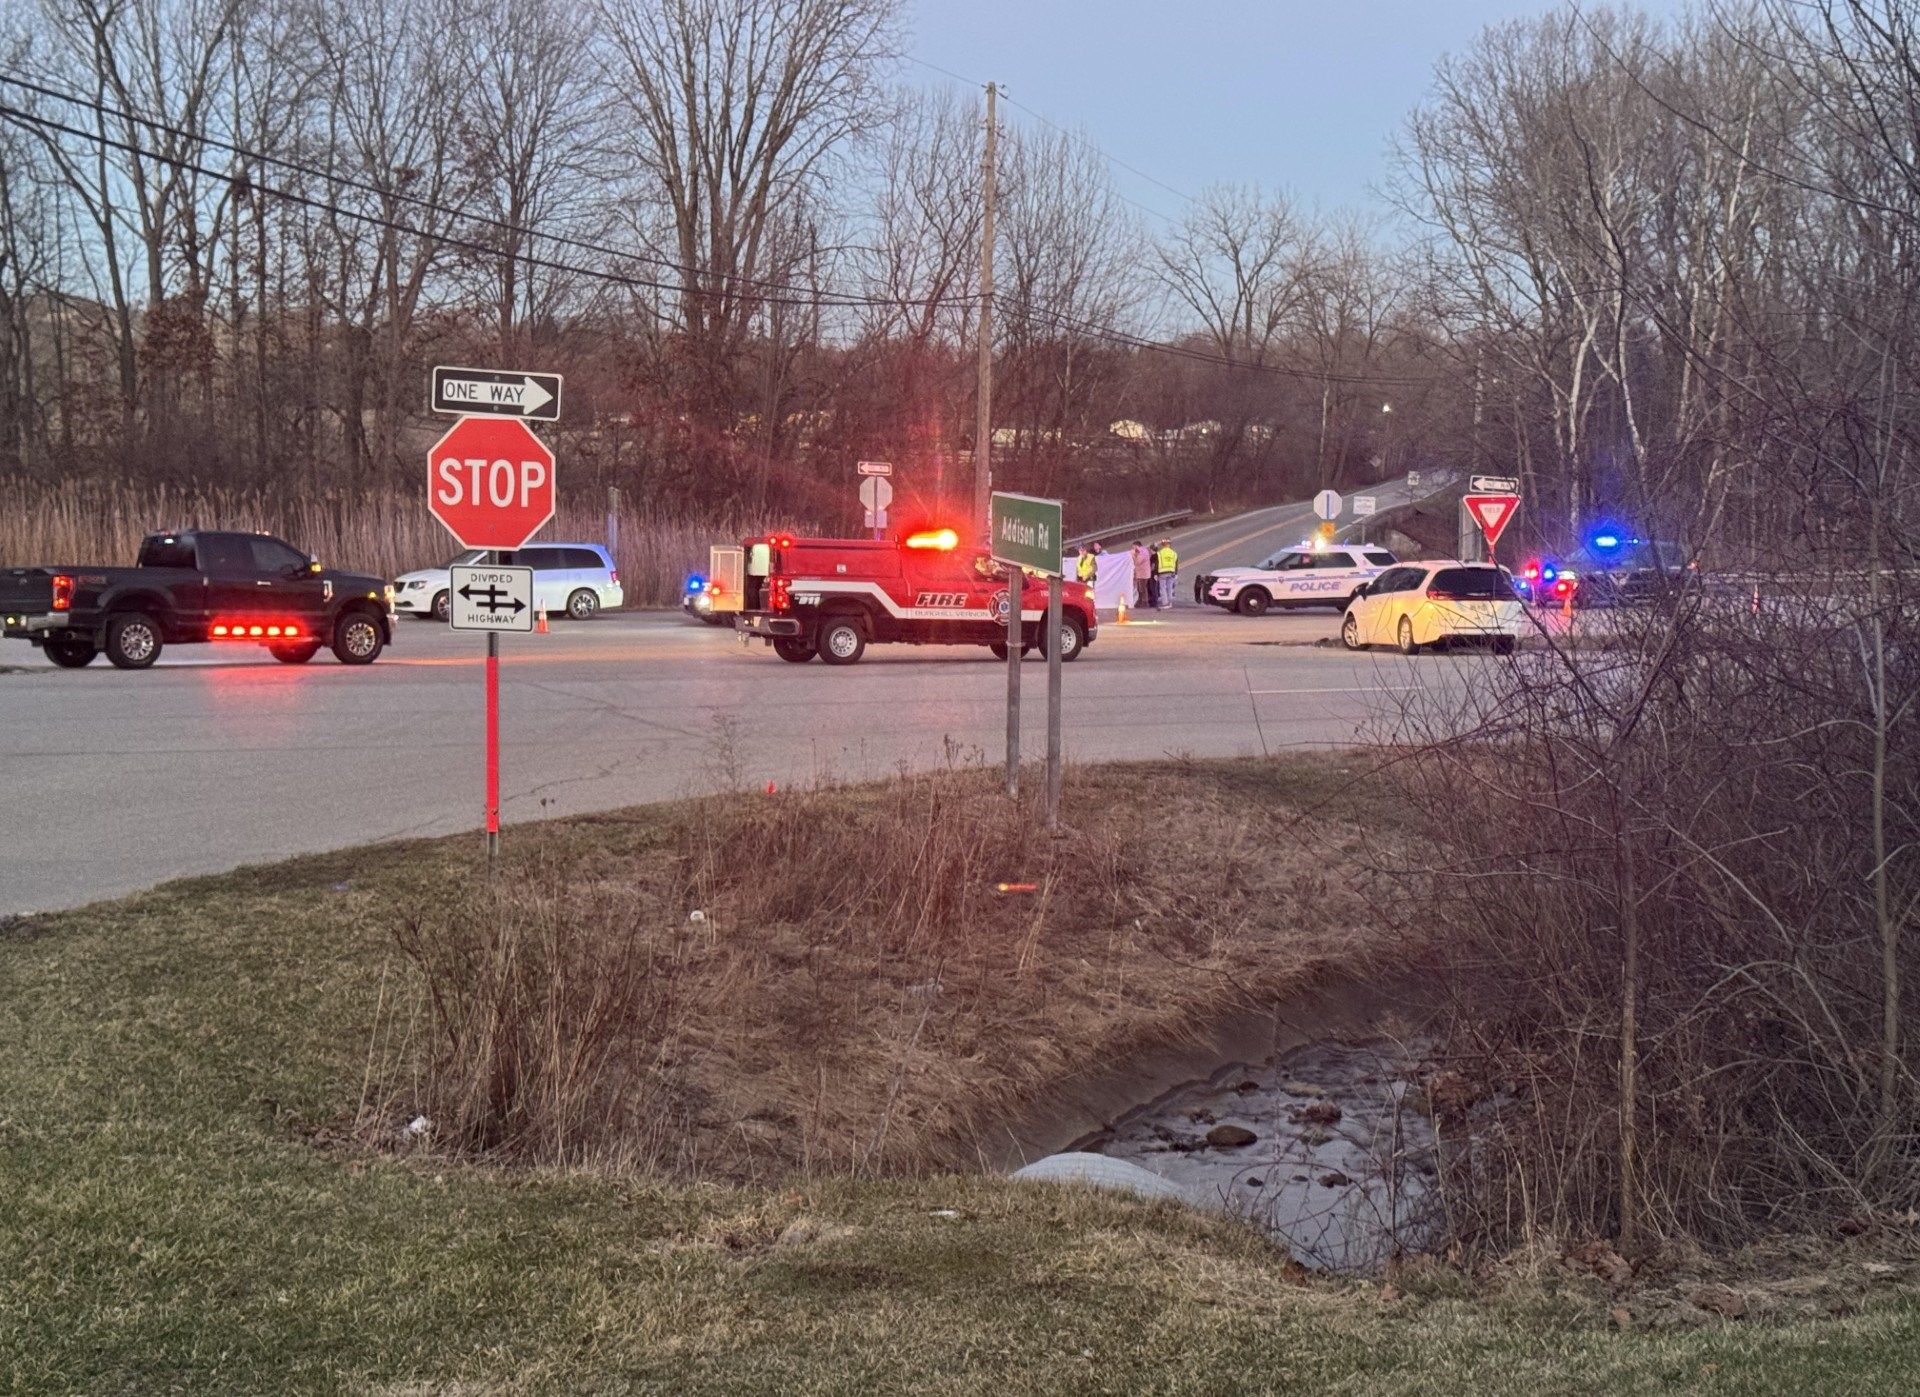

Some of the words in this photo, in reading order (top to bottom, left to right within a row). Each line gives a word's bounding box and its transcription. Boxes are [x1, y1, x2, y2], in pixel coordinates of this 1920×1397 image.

[445, 381, 478, 400] ONE
[490, 385, 524, 403] WAY
[438, 457, 546, 508] STOP
[1001, 516, 1035, 547] Addison
[1038, 522, 1049, 550] Rd
[470, 573, 513, 584] DIVIDED
[1290, 581, 1341, 592] POLICE
[915, 592, 968, 607] FIRE
[467, 613, 516, 625] HIGHWAY
